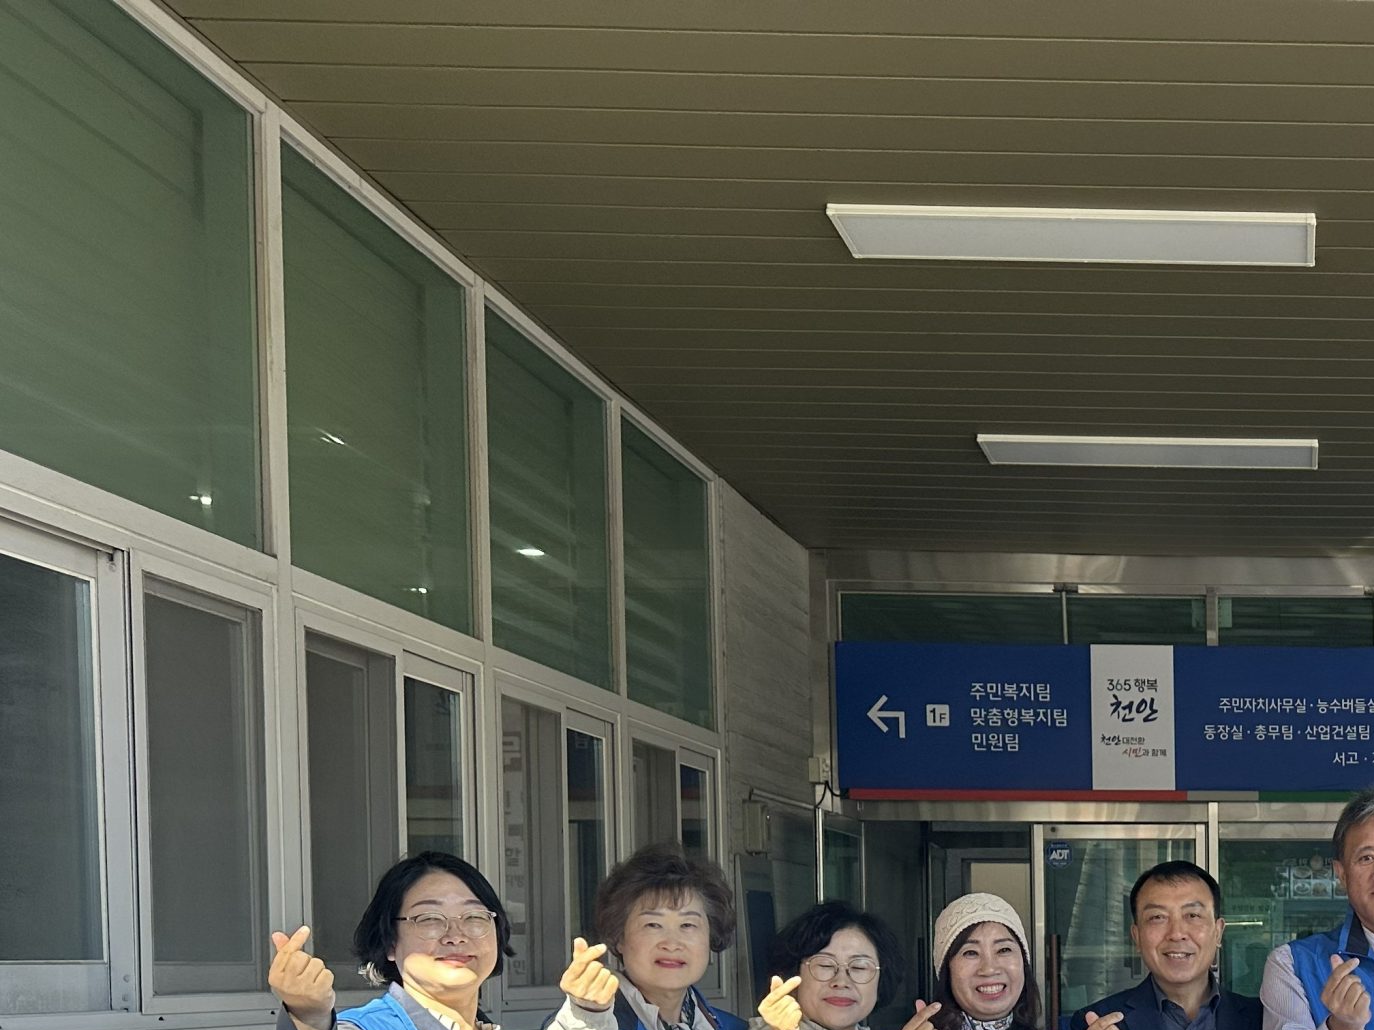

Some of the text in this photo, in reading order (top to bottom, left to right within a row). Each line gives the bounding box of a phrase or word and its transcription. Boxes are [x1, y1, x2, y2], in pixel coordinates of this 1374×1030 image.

[970, 682, 1050, 701] 주민복지팀
[1107, 679, 1158, 692] 365 행복
[1110, 694, 1158, 722] 천안
[1219, 698, 1306, 713] 주민자치사무실
[928, 707, 947, 724] 1F
[970, 708, 1068, 726] 맞춤형복지팀
[1204, 725, 1243, 740] 동장실
[1254, 725, 1293, 740] 총무팀
[1305, 725, 1370, 740] 산업건설팀
[972, 733, 1019, 751] 민원팀
[1333, 752, 1359, 766] 서고
[1050, 849, 1069, 860] ADT
